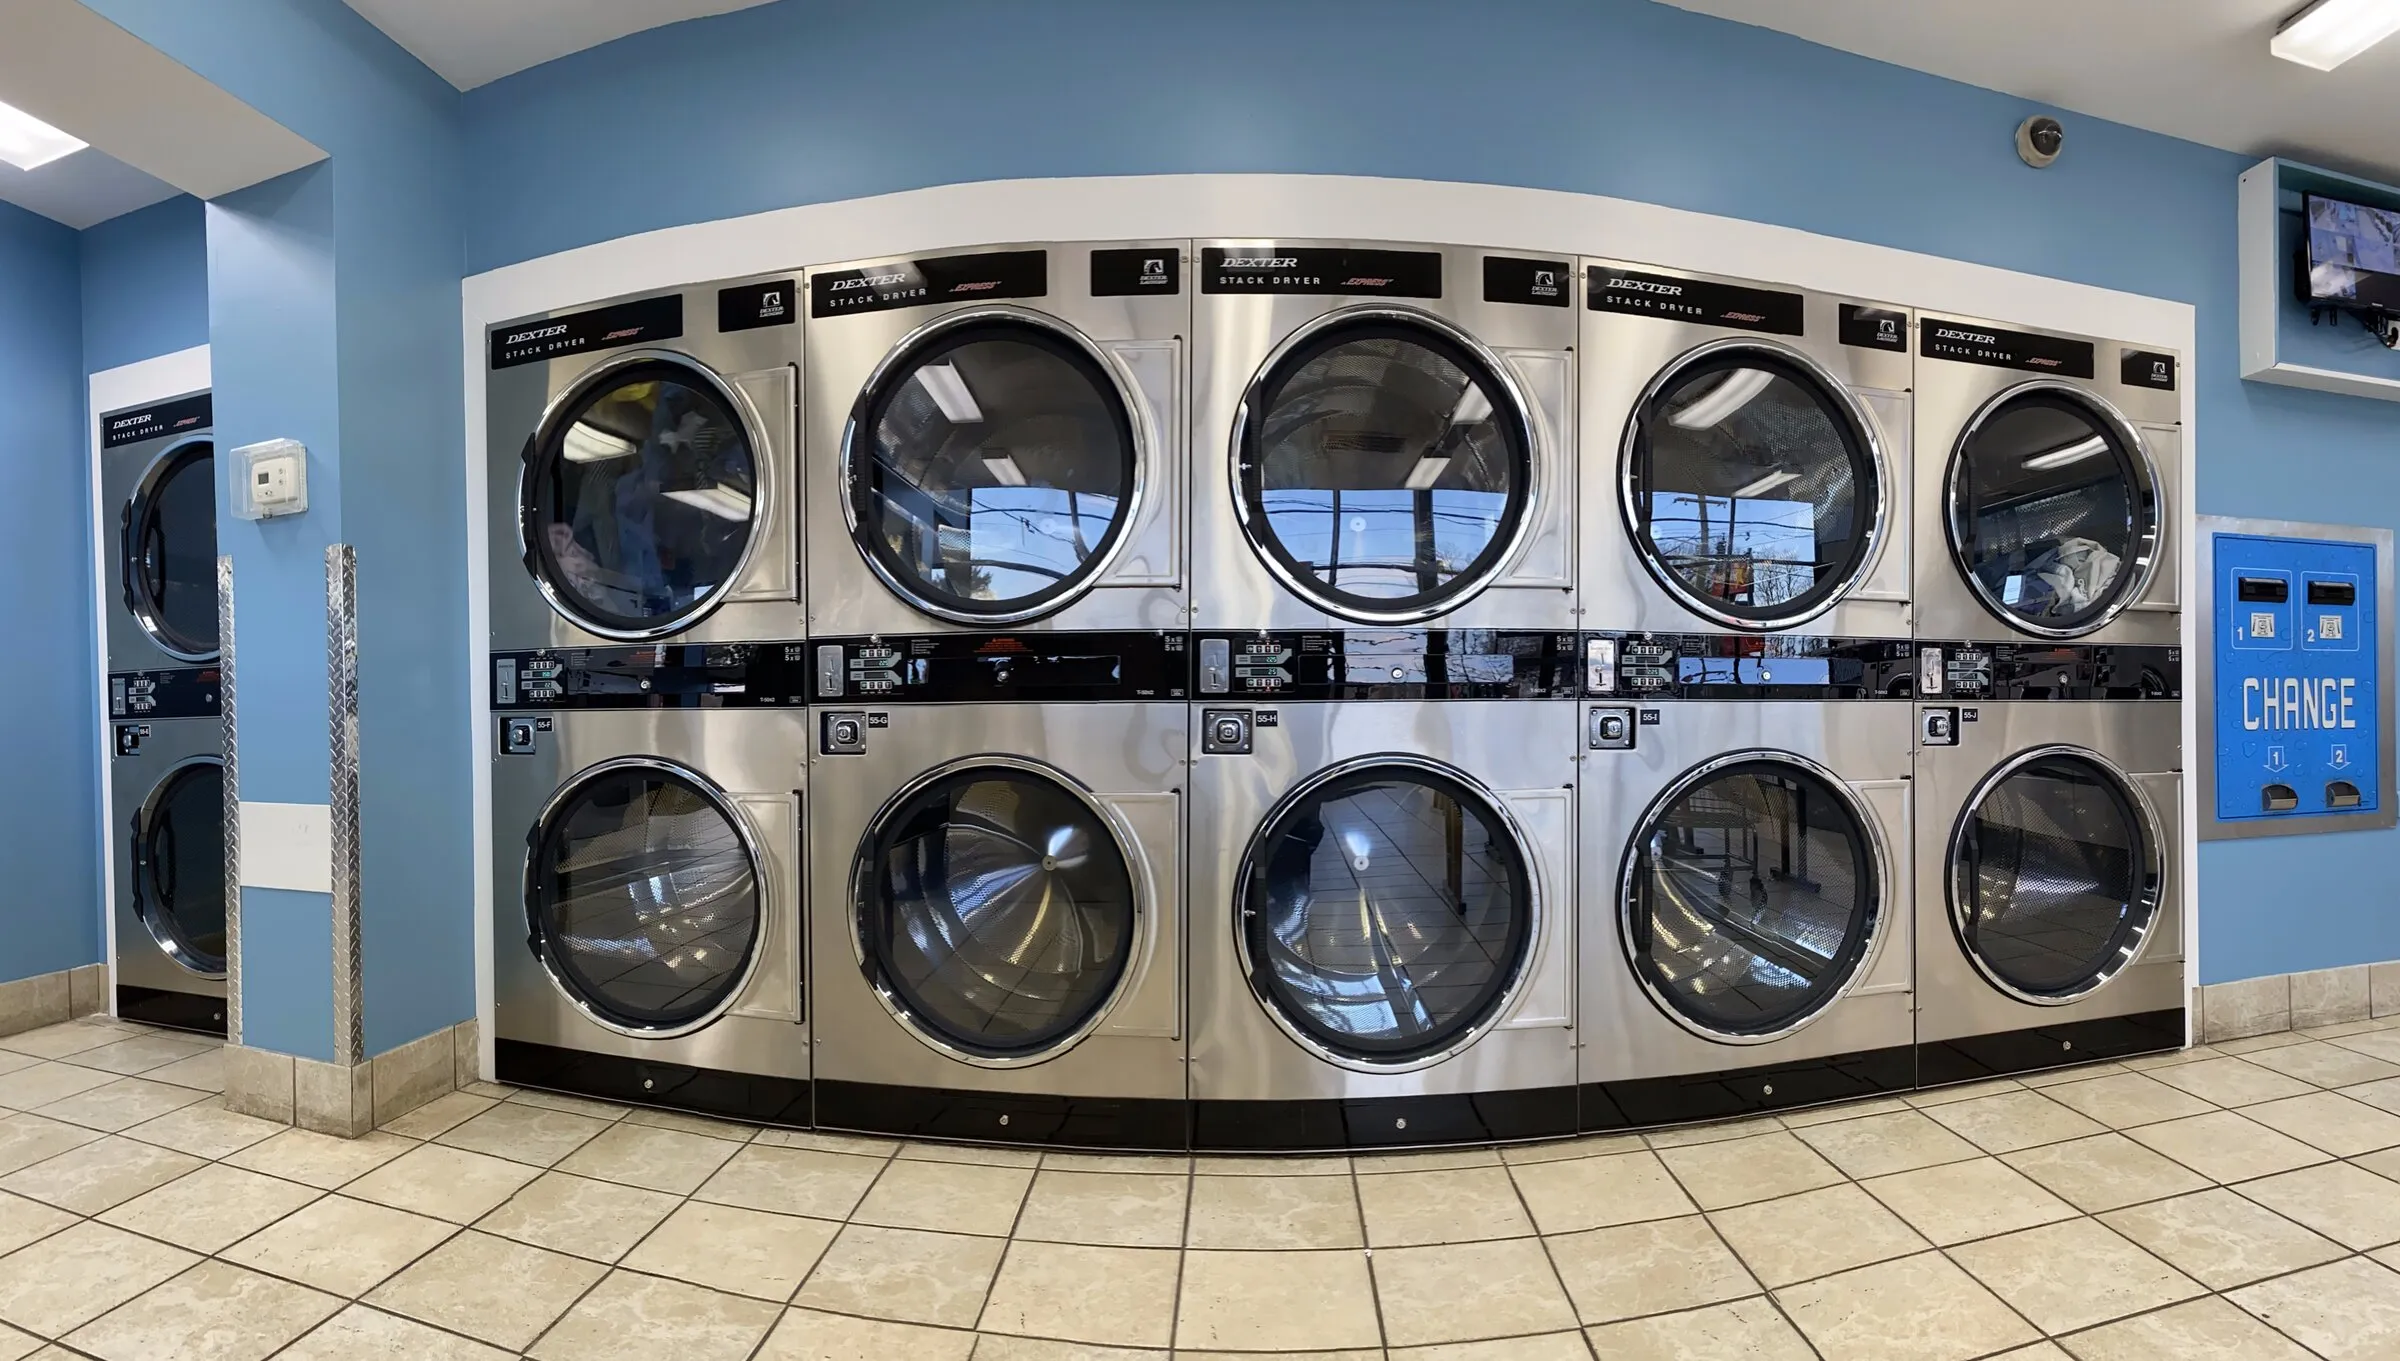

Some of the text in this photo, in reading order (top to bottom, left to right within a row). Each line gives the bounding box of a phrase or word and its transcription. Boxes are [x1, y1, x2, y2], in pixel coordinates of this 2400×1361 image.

[1220, 257, 1299, 268] DEXTER
[830, 273, 906, 291] DEXTER
[1219, 276, 1321, 285] STACK DRYER
[1606, 278, 1683, 296] DEXTER
[829, 288, 927, 307] STACK DRYER
[1606, 295, 1703, 315] STACK DRYER
[506, 324, 567, 344] DEXTER
[1935, 328, 1996, 345] DEXTER
[505, 338, 585, 359] STACK DRYER
[1935, 343, 2012, 360] STACK DRYER
[112, 414, 152, 429] DEXTER
[112, 424, 163, 441] STACK DRYER
[2237, 626, 2244, 641] 1
[2307, 628, 2315, 643] 2
[2243, 677, 2356, 730] CHANGE
[1257, 714, 1277, 722] 55-H
[1643, 713, 1658, 721] 55-I
[1963, 711, 1977, 719] 55-J
[2273, 751, 2279, 766] 1
[2335, 750, 2343, 763] 2
